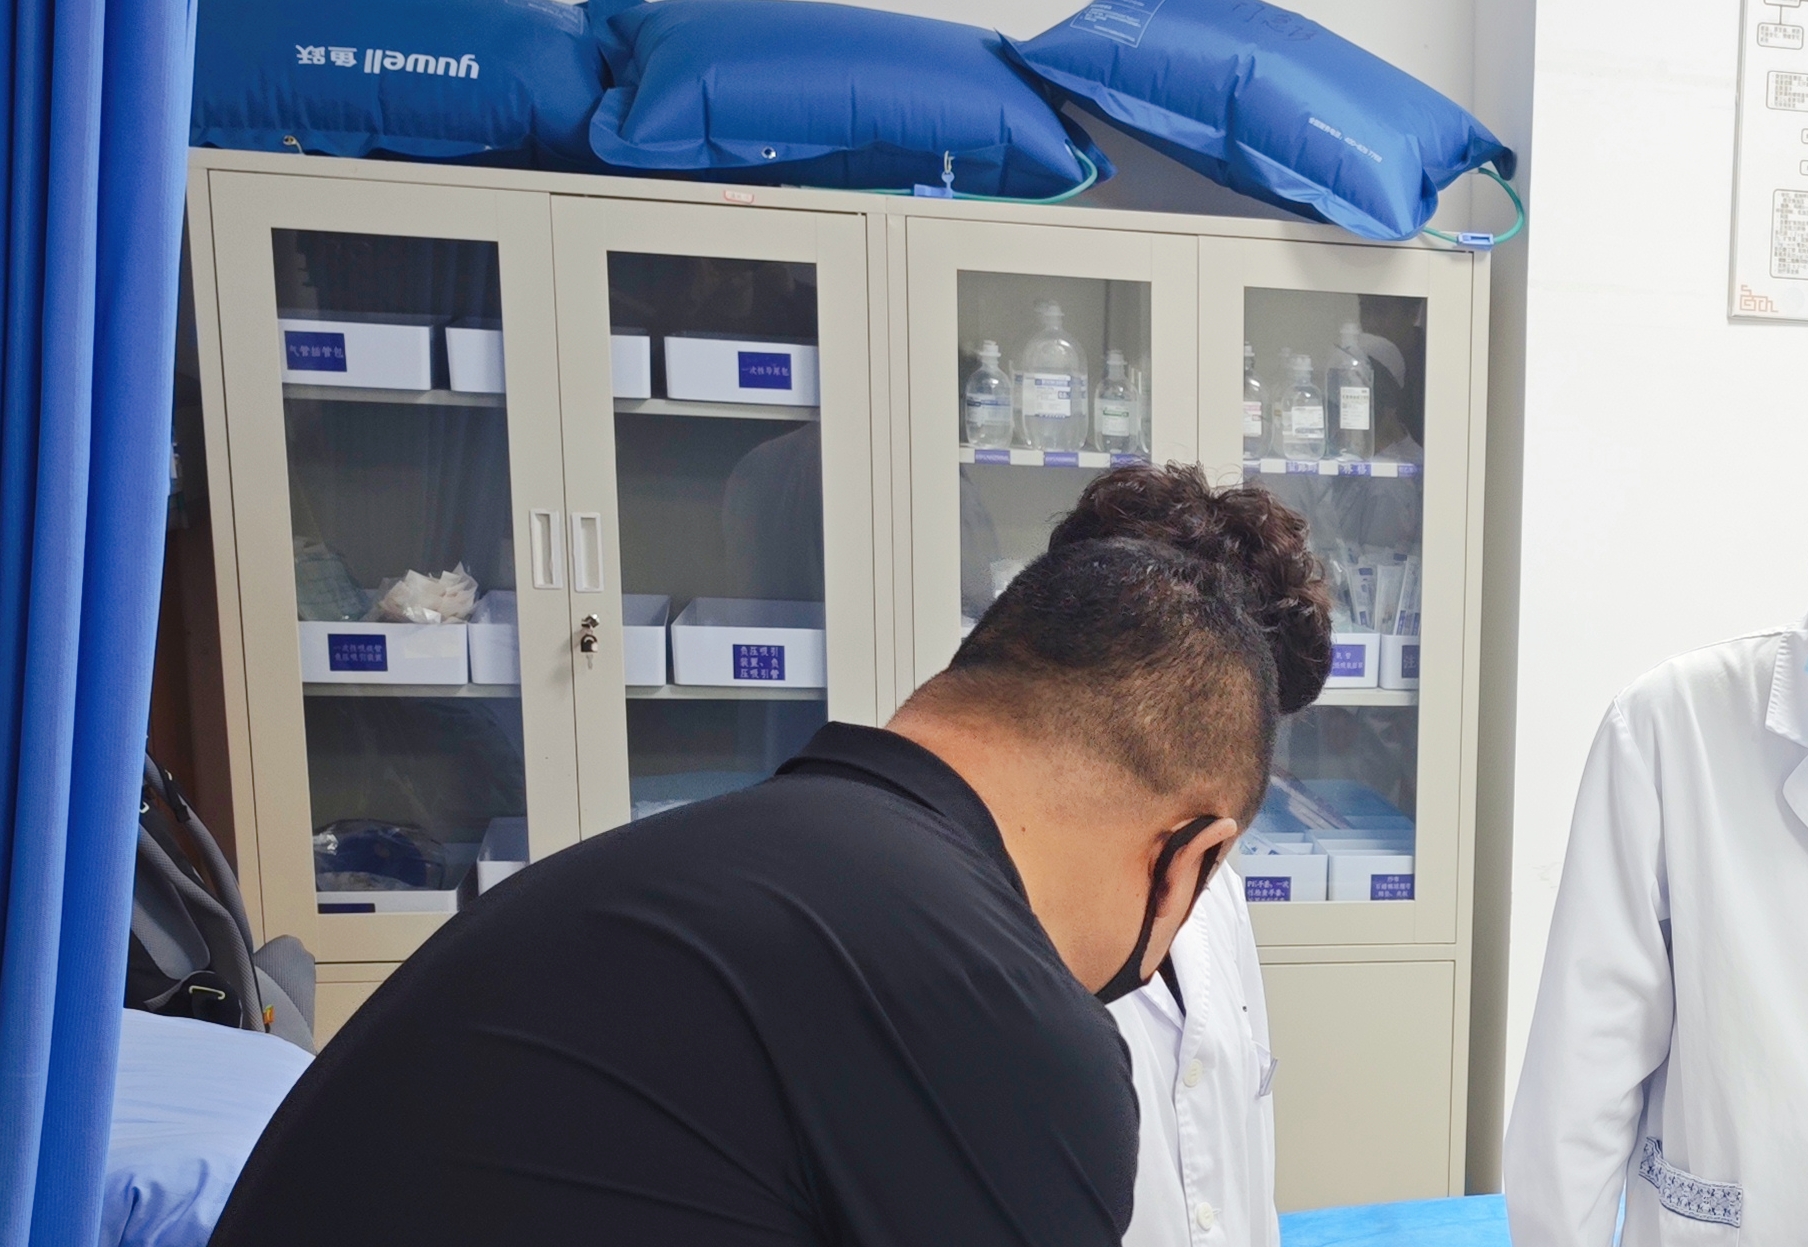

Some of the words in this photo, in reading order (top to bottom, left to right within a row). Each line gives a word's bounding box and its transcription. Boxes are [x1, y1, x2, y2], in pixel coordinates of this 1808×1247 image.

[295, 44, 358, 68] 鱼跃
[363, 48, 480, 80] yuwell
[289, 344, 344, 358] 气管插管包
[740, 646, 779, 657] 负压吸引
[740, 668, 780, 680] 压吸引管
